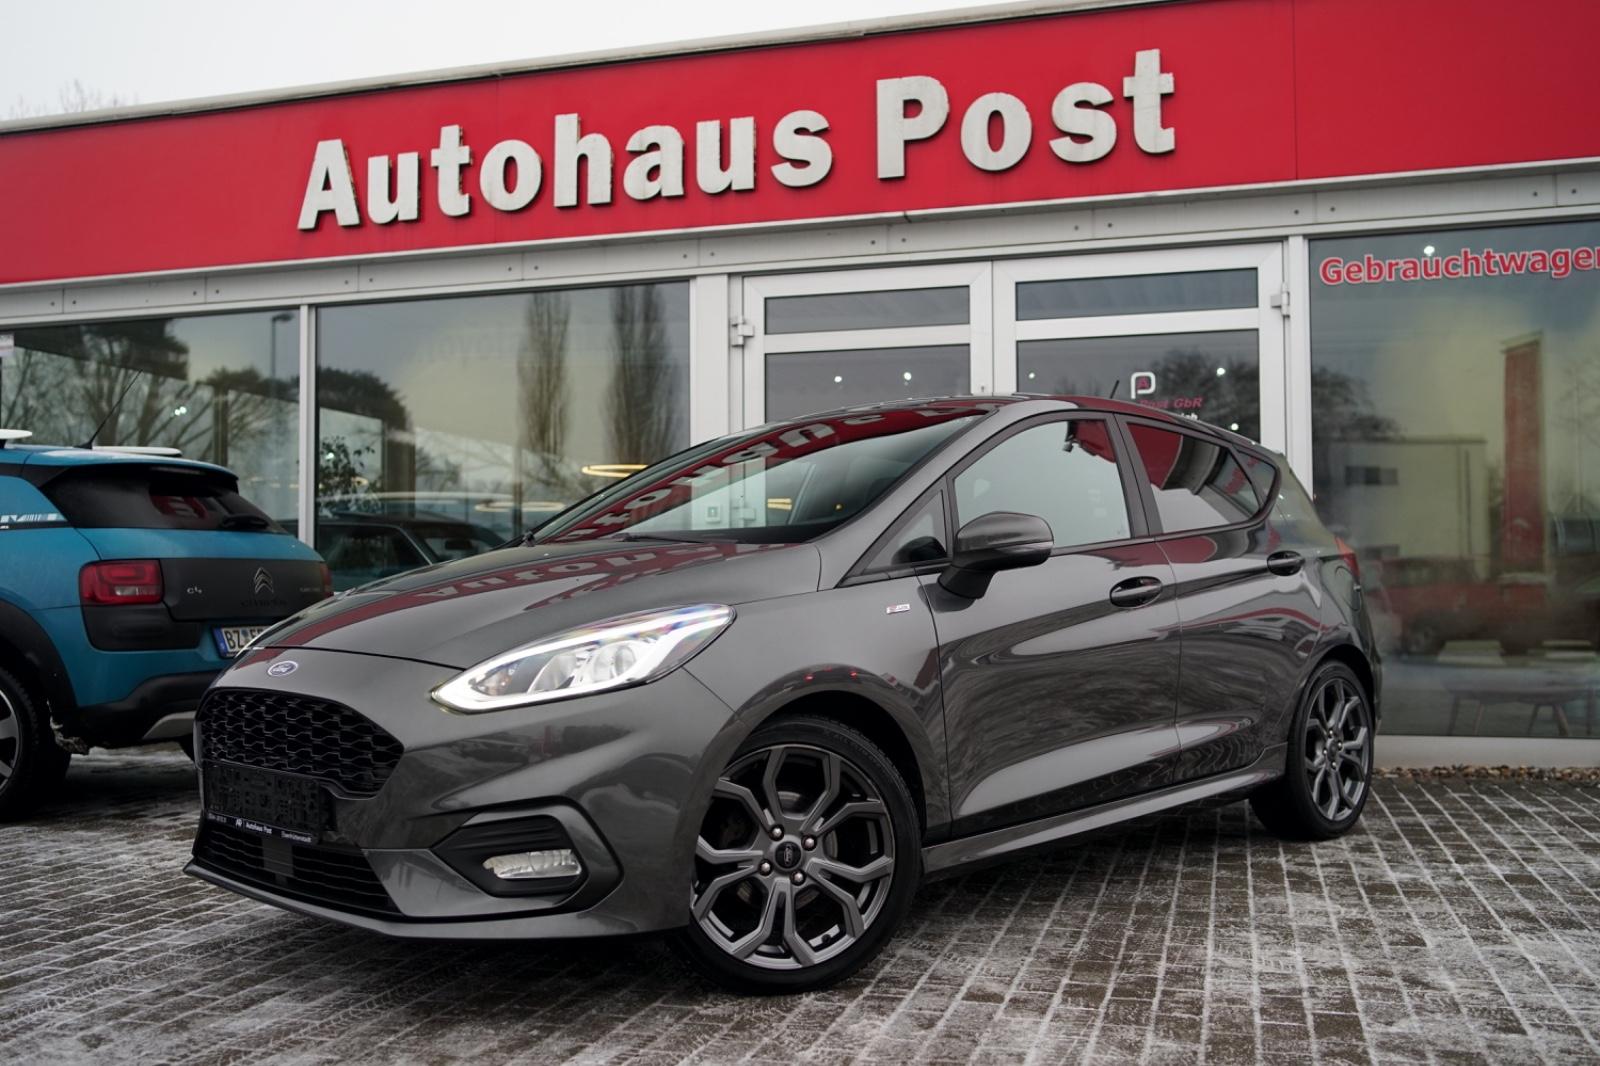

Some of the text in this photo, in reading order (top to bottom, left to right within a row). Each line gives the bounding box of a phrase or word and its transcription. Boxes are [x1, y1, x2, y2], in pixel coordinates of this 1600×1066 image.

[297, 48, 1176, 230] Autohaus Post
[1319, 246, 1600, 286] Gebrauchtwage
[1174, 397, 1204, 408] GbR
